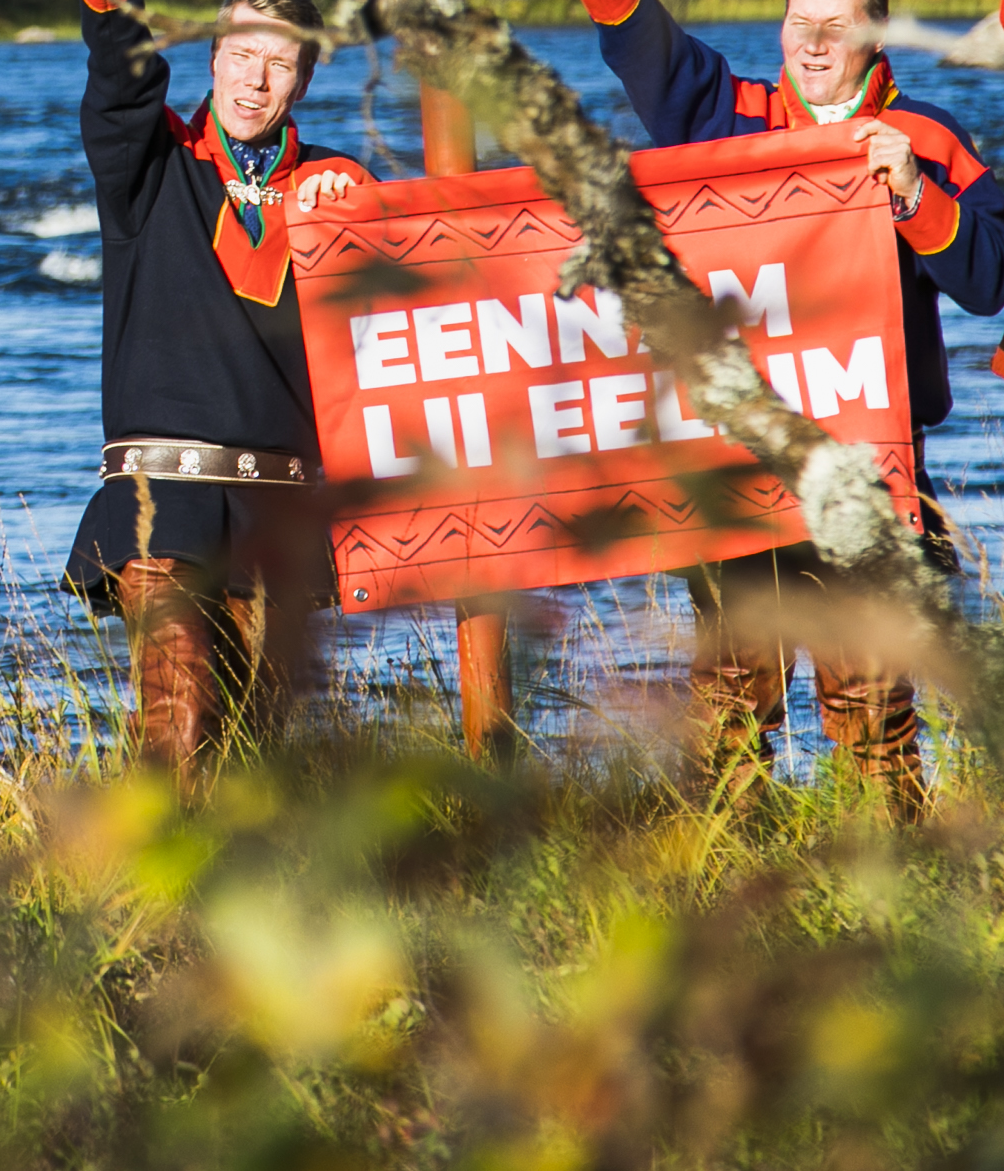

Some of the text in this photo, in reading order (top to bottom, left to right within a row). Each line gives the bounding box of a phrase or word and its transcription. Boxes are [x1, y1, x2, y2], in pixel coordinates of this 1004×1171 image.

[350, 262, 793, 391] EENNM
[362, 336, 890, 479] LII EELIM
